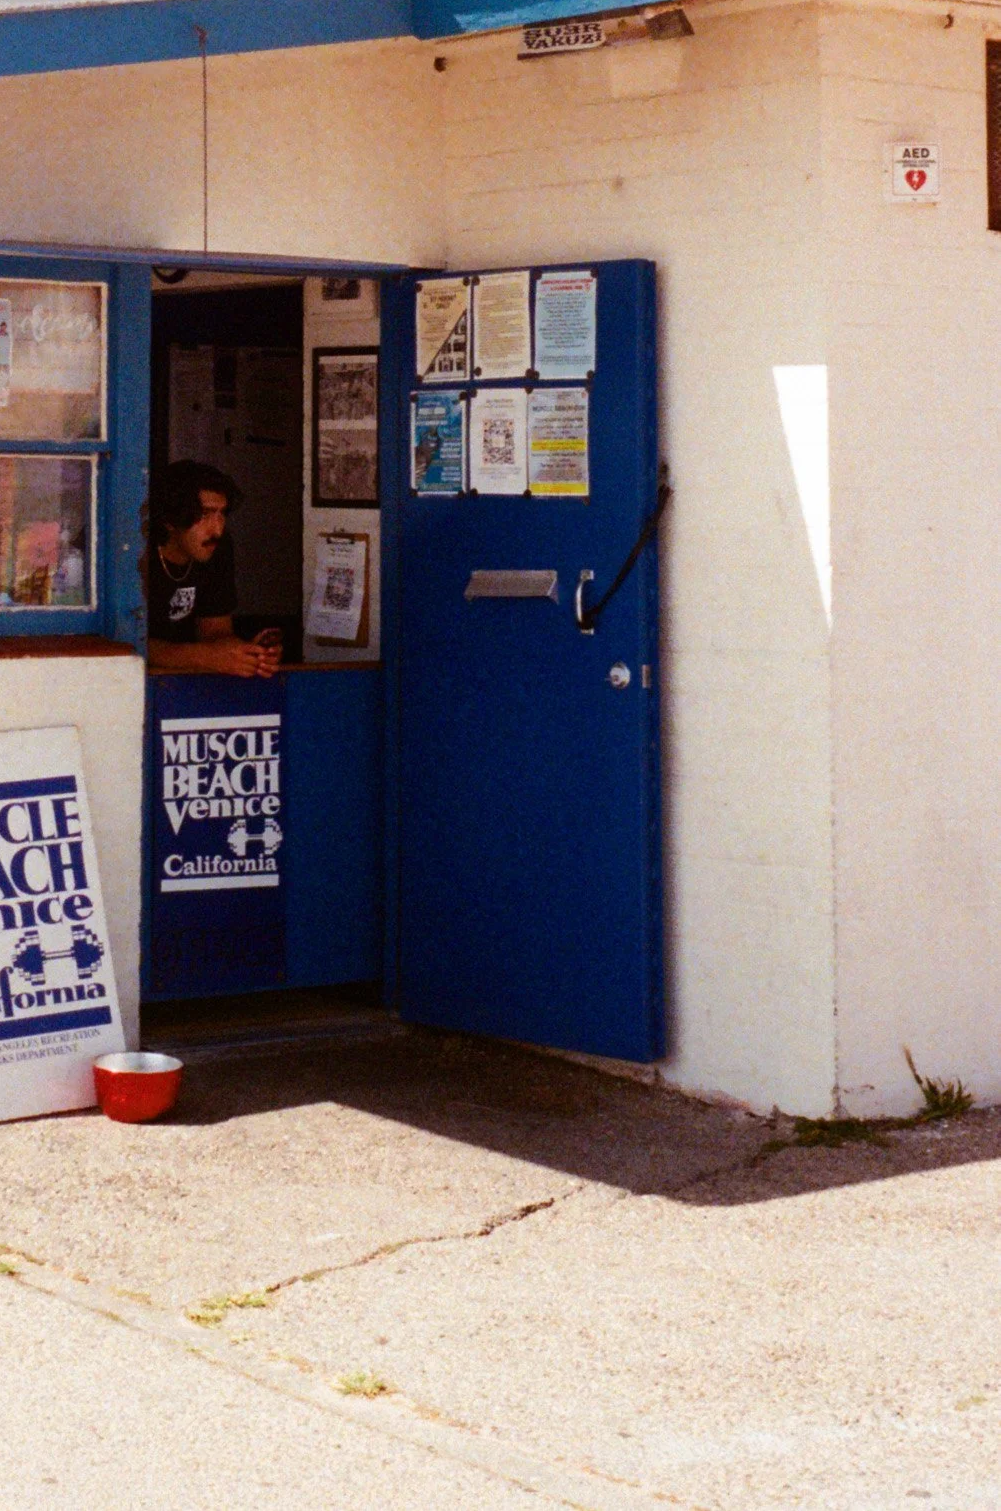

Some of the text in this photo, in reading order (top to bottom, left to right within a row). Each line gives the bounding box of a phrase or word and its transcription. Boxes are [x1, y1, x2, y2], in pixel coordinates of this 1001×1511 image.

[903, 148, 930, 158] AED
[162, 730, 280, 764] MUSCLE
[163, 760, 280, 799] BEACH
[163, 795, 281, 836] Venice
[164, 854, 277, 876] California
[40, 1028, 101, 1045] RECREATION
[16, 1043, 79, 1062] DEPARTMENT
